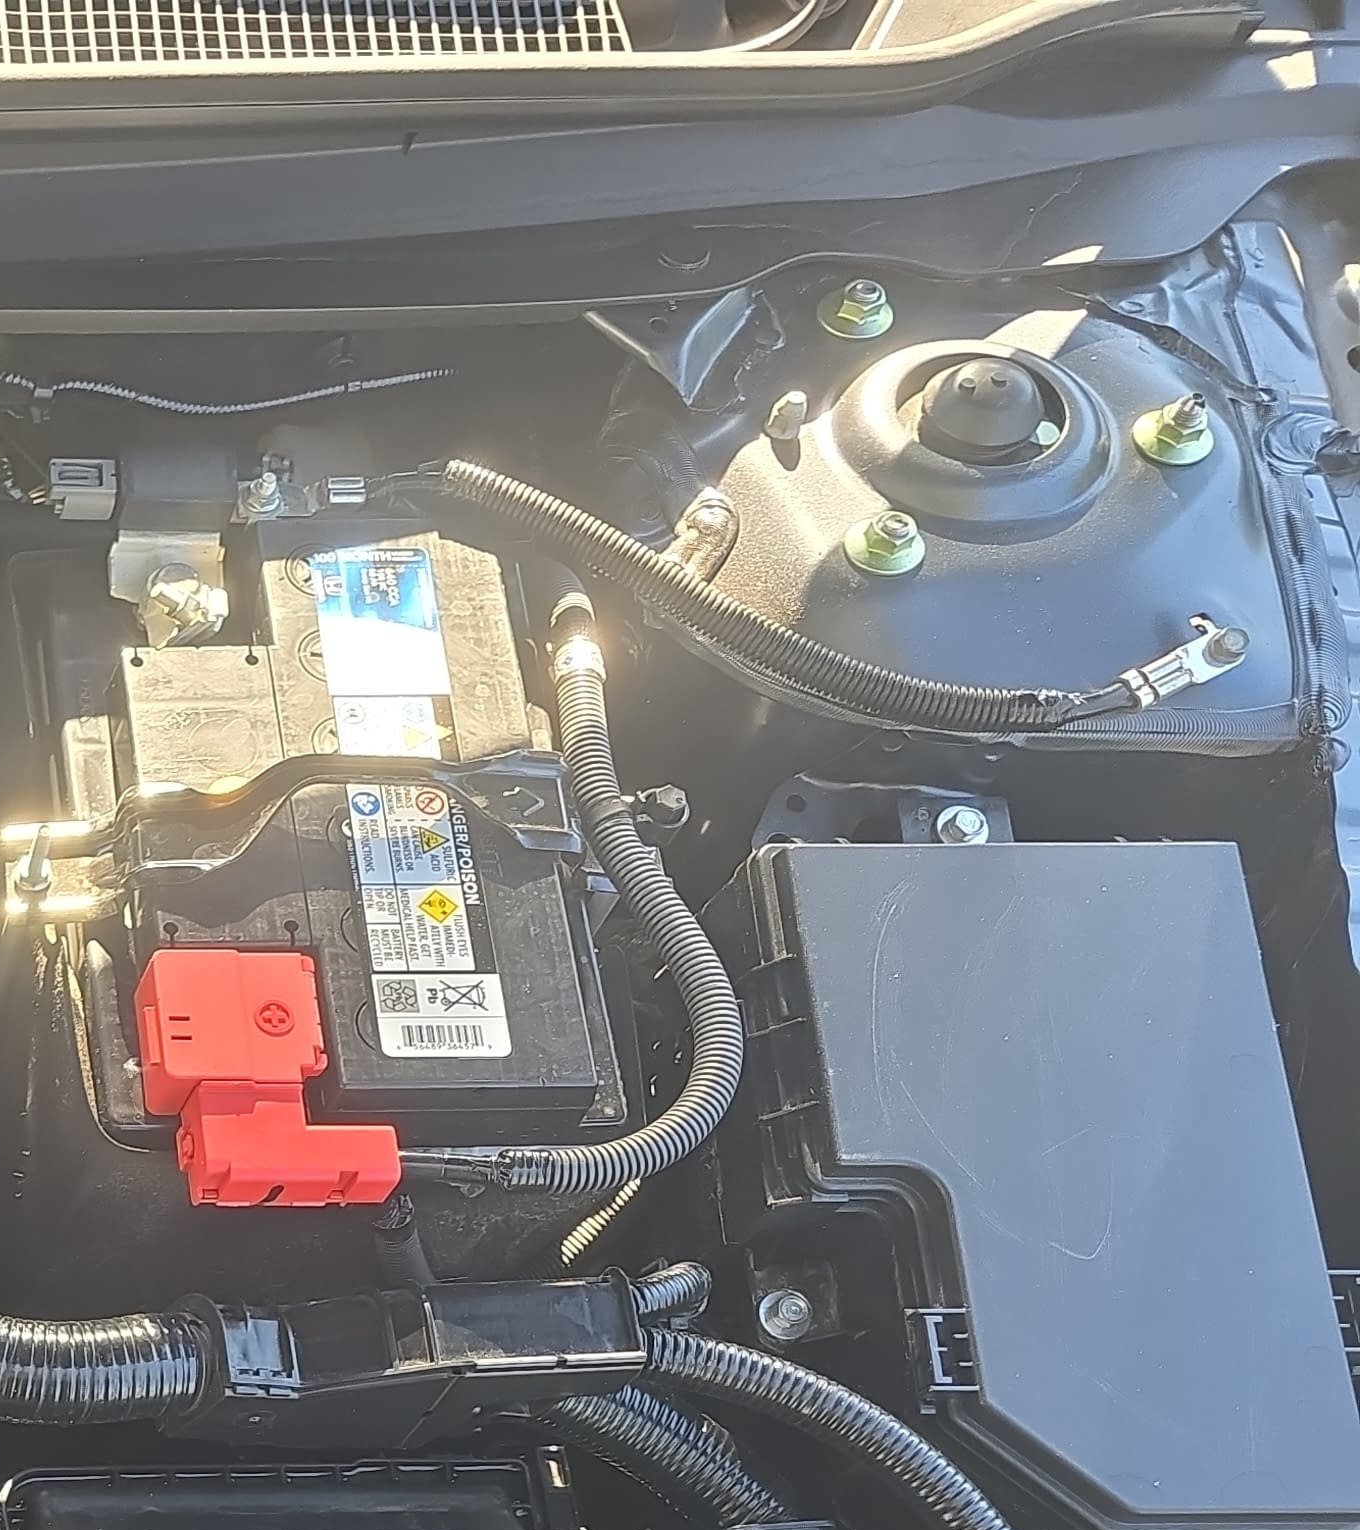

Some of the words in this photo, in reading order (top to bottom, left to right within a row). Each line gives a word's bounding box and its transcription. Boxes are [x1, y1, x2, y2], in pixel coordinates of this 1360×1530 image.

[369, 819, 380, 838] READ
[449, 798, 481, 906] NGER/POISON
[430, 854, 441, 872] ACID
[442, 845, 457, 881] SULFURIC
[385, 887, 395, 900] DO
[387, 901, 397, 917] NOT
[399, 888, 413, 922] MEDICAL
[403, 923, 414, 943] HELP
[429, 925, 442, 947] ATELY
[454, 914, 466, 938] FLUSH
[370, 928, 382, 967] RECYCLED
[380, 928, 391, 950] MUST
[391, 928, 403, 961] BATTERY
[420, 943, 430, 958] GET
[434, 947, 445, 967] WITH
[426, 988, 439, 1005] Pb
